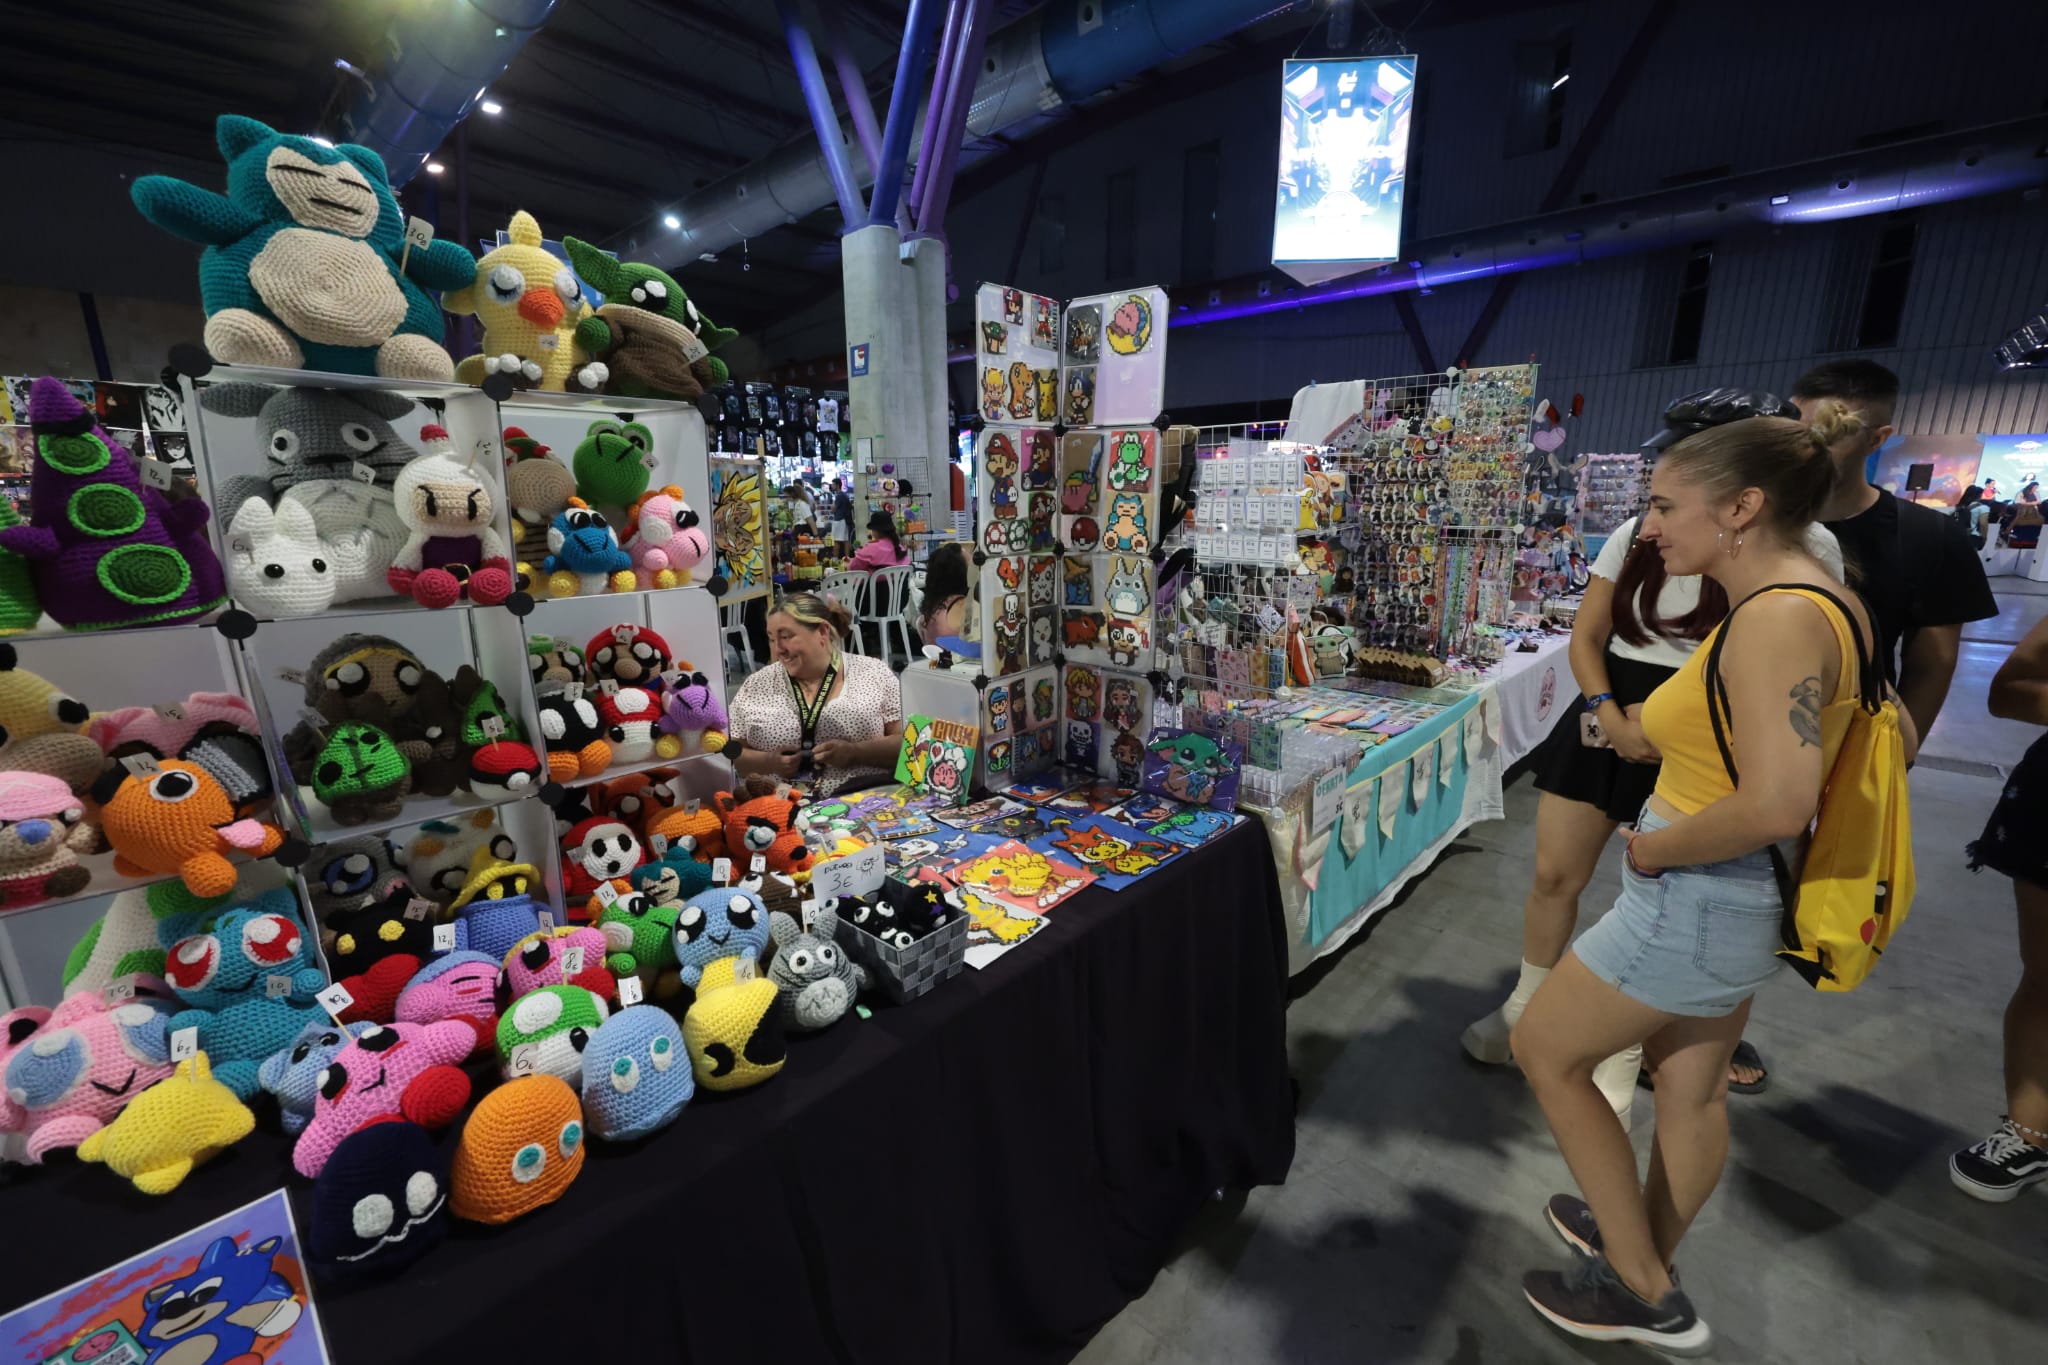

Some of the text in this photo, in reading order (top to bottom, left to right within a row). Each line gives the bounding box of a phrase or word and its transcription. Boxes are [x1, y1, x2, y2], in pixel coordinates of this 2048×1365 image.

[829, 874, 852, 892] 3€
[565, 952, 578, 970] 8€
[515, 1048, 533, 1070] 6€
